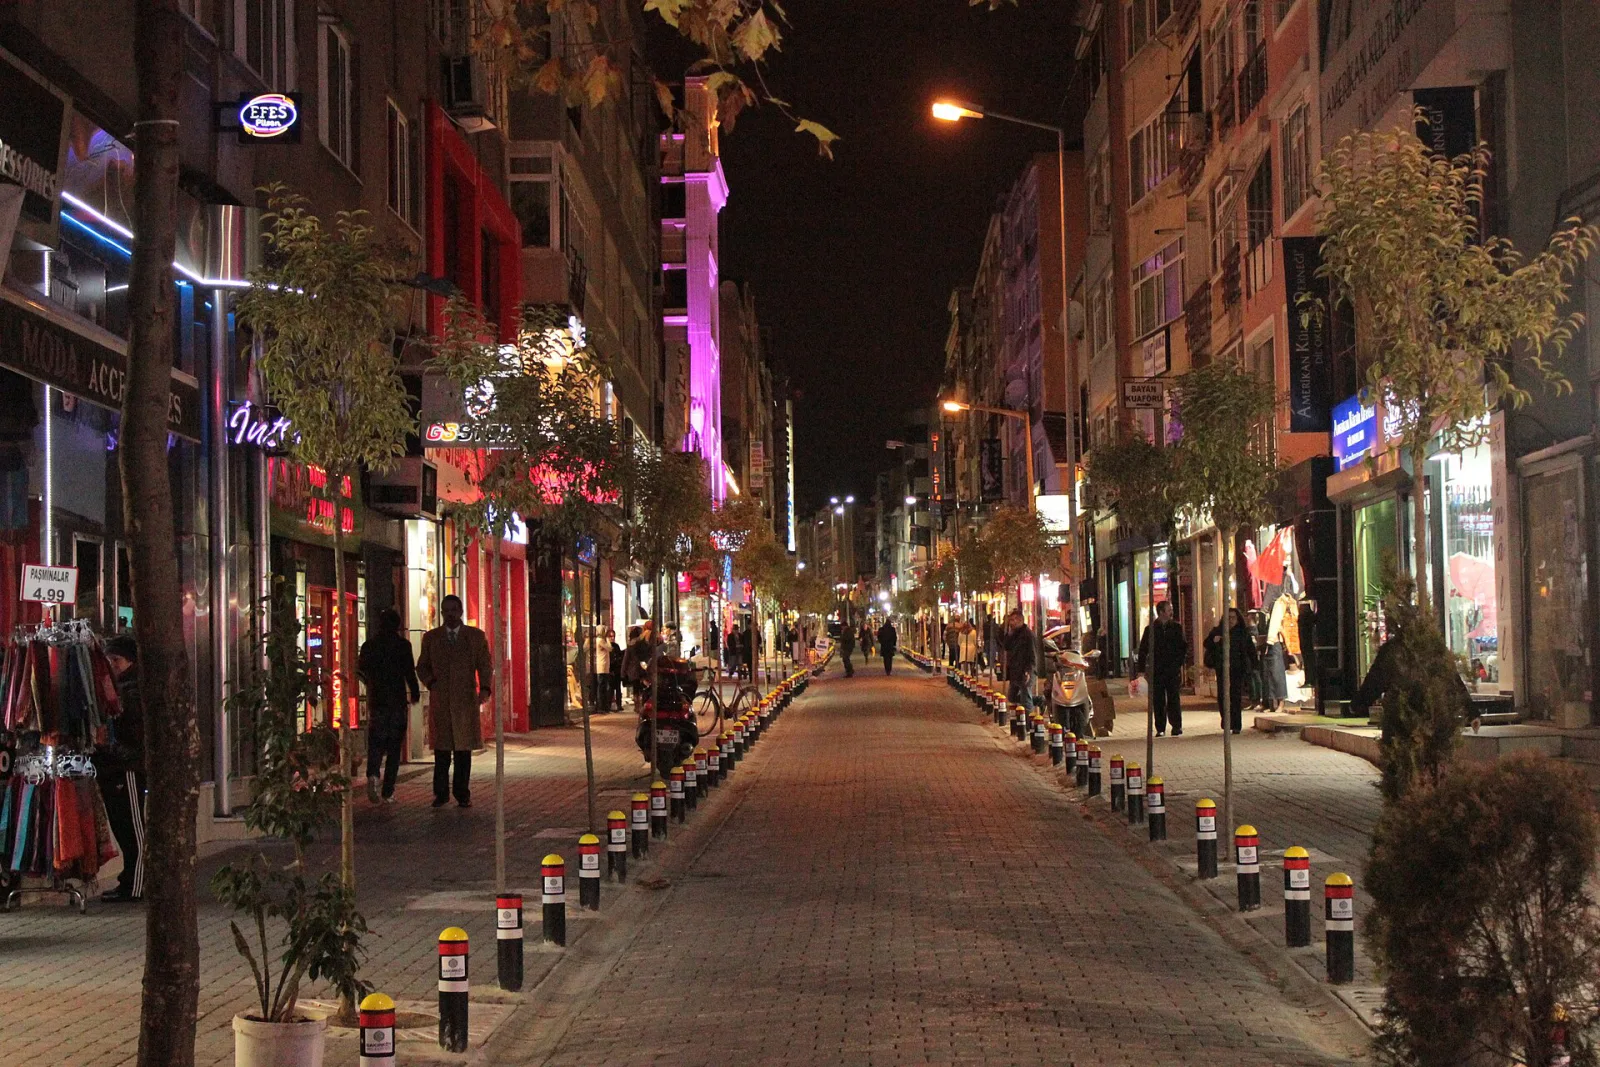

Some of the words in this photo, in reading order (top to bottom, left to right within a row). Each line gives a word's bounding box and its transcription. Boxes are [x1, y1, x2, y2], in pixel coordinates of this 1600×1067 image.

[250, 105, 287, 119] EFES
[22, 320, 79, 384] MODA
[1131, 385, 1157, 393] BAYAN
[32, 587, 66, 602] 4.99
